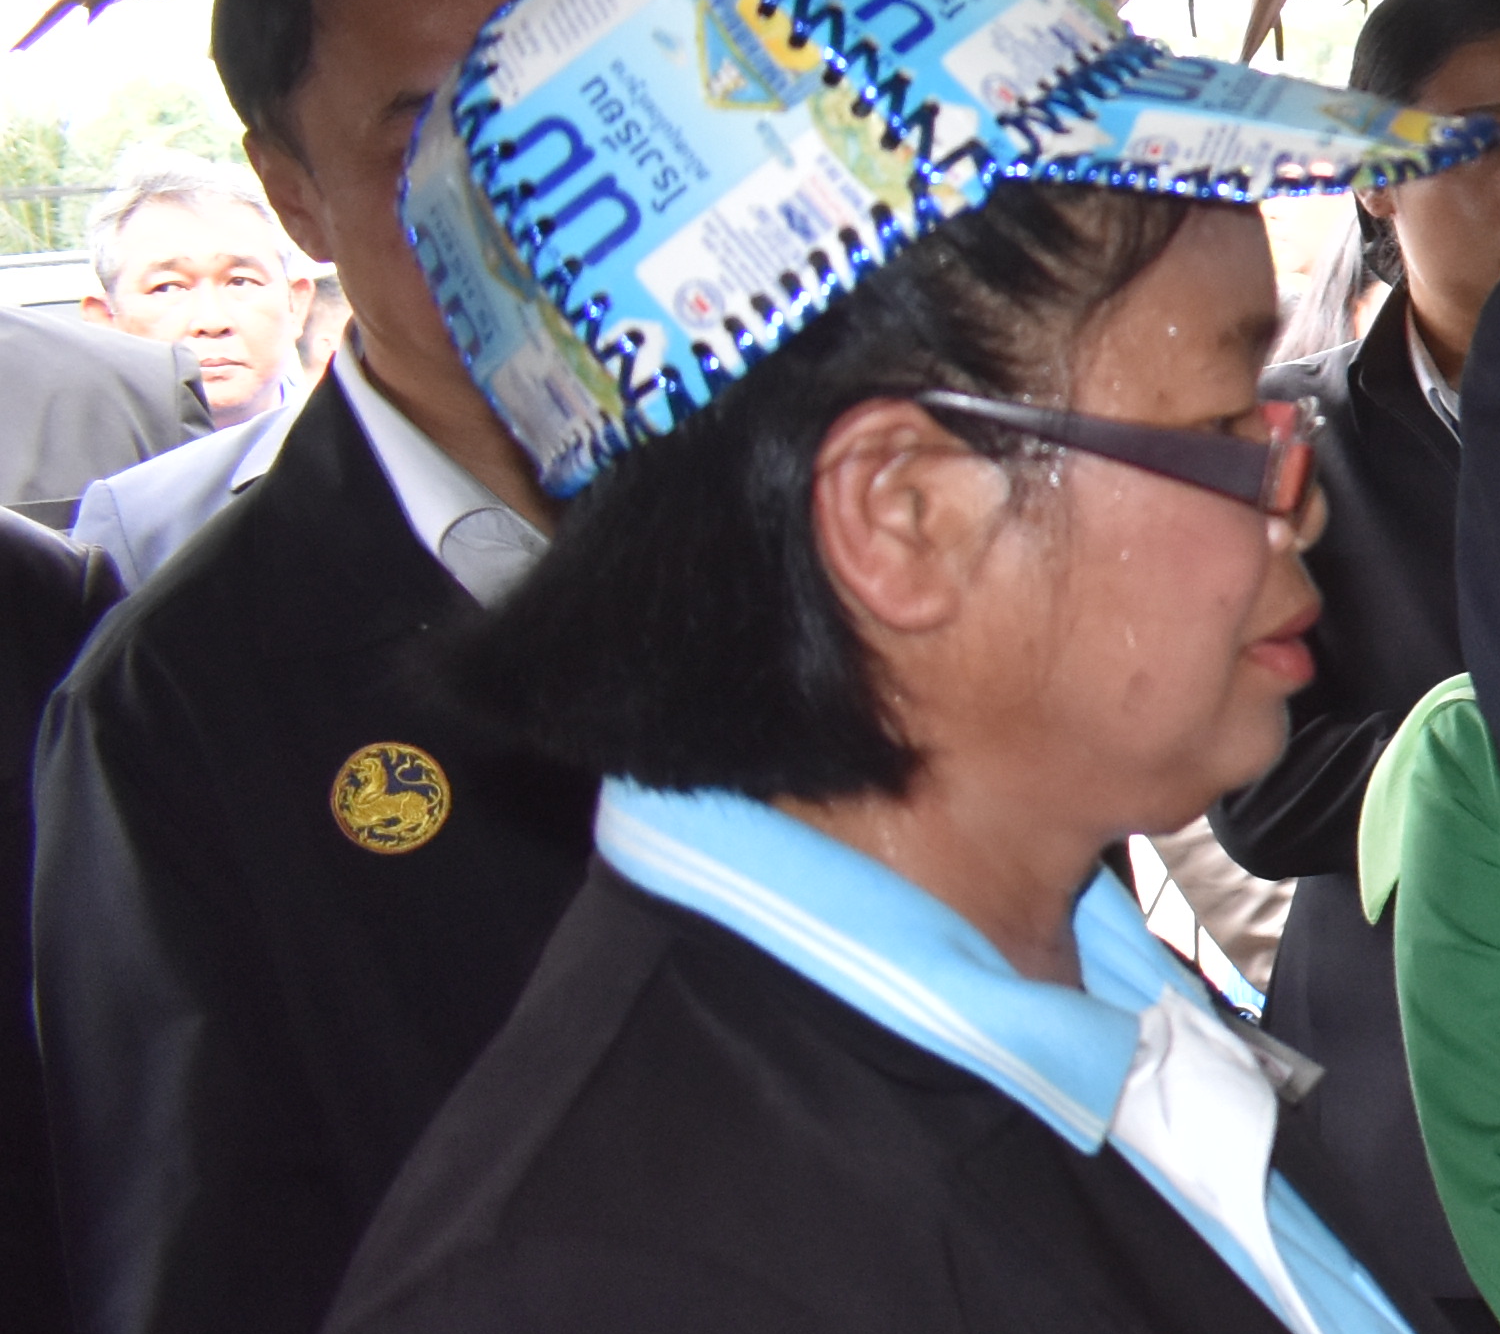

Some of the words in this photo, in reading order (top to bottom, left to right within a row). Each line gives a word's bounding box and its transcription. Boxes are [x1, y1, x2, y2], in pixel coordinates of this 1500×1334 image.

[512, 114, 643, 267] นม
[579, 75, 688, 214] โรงเรียน
